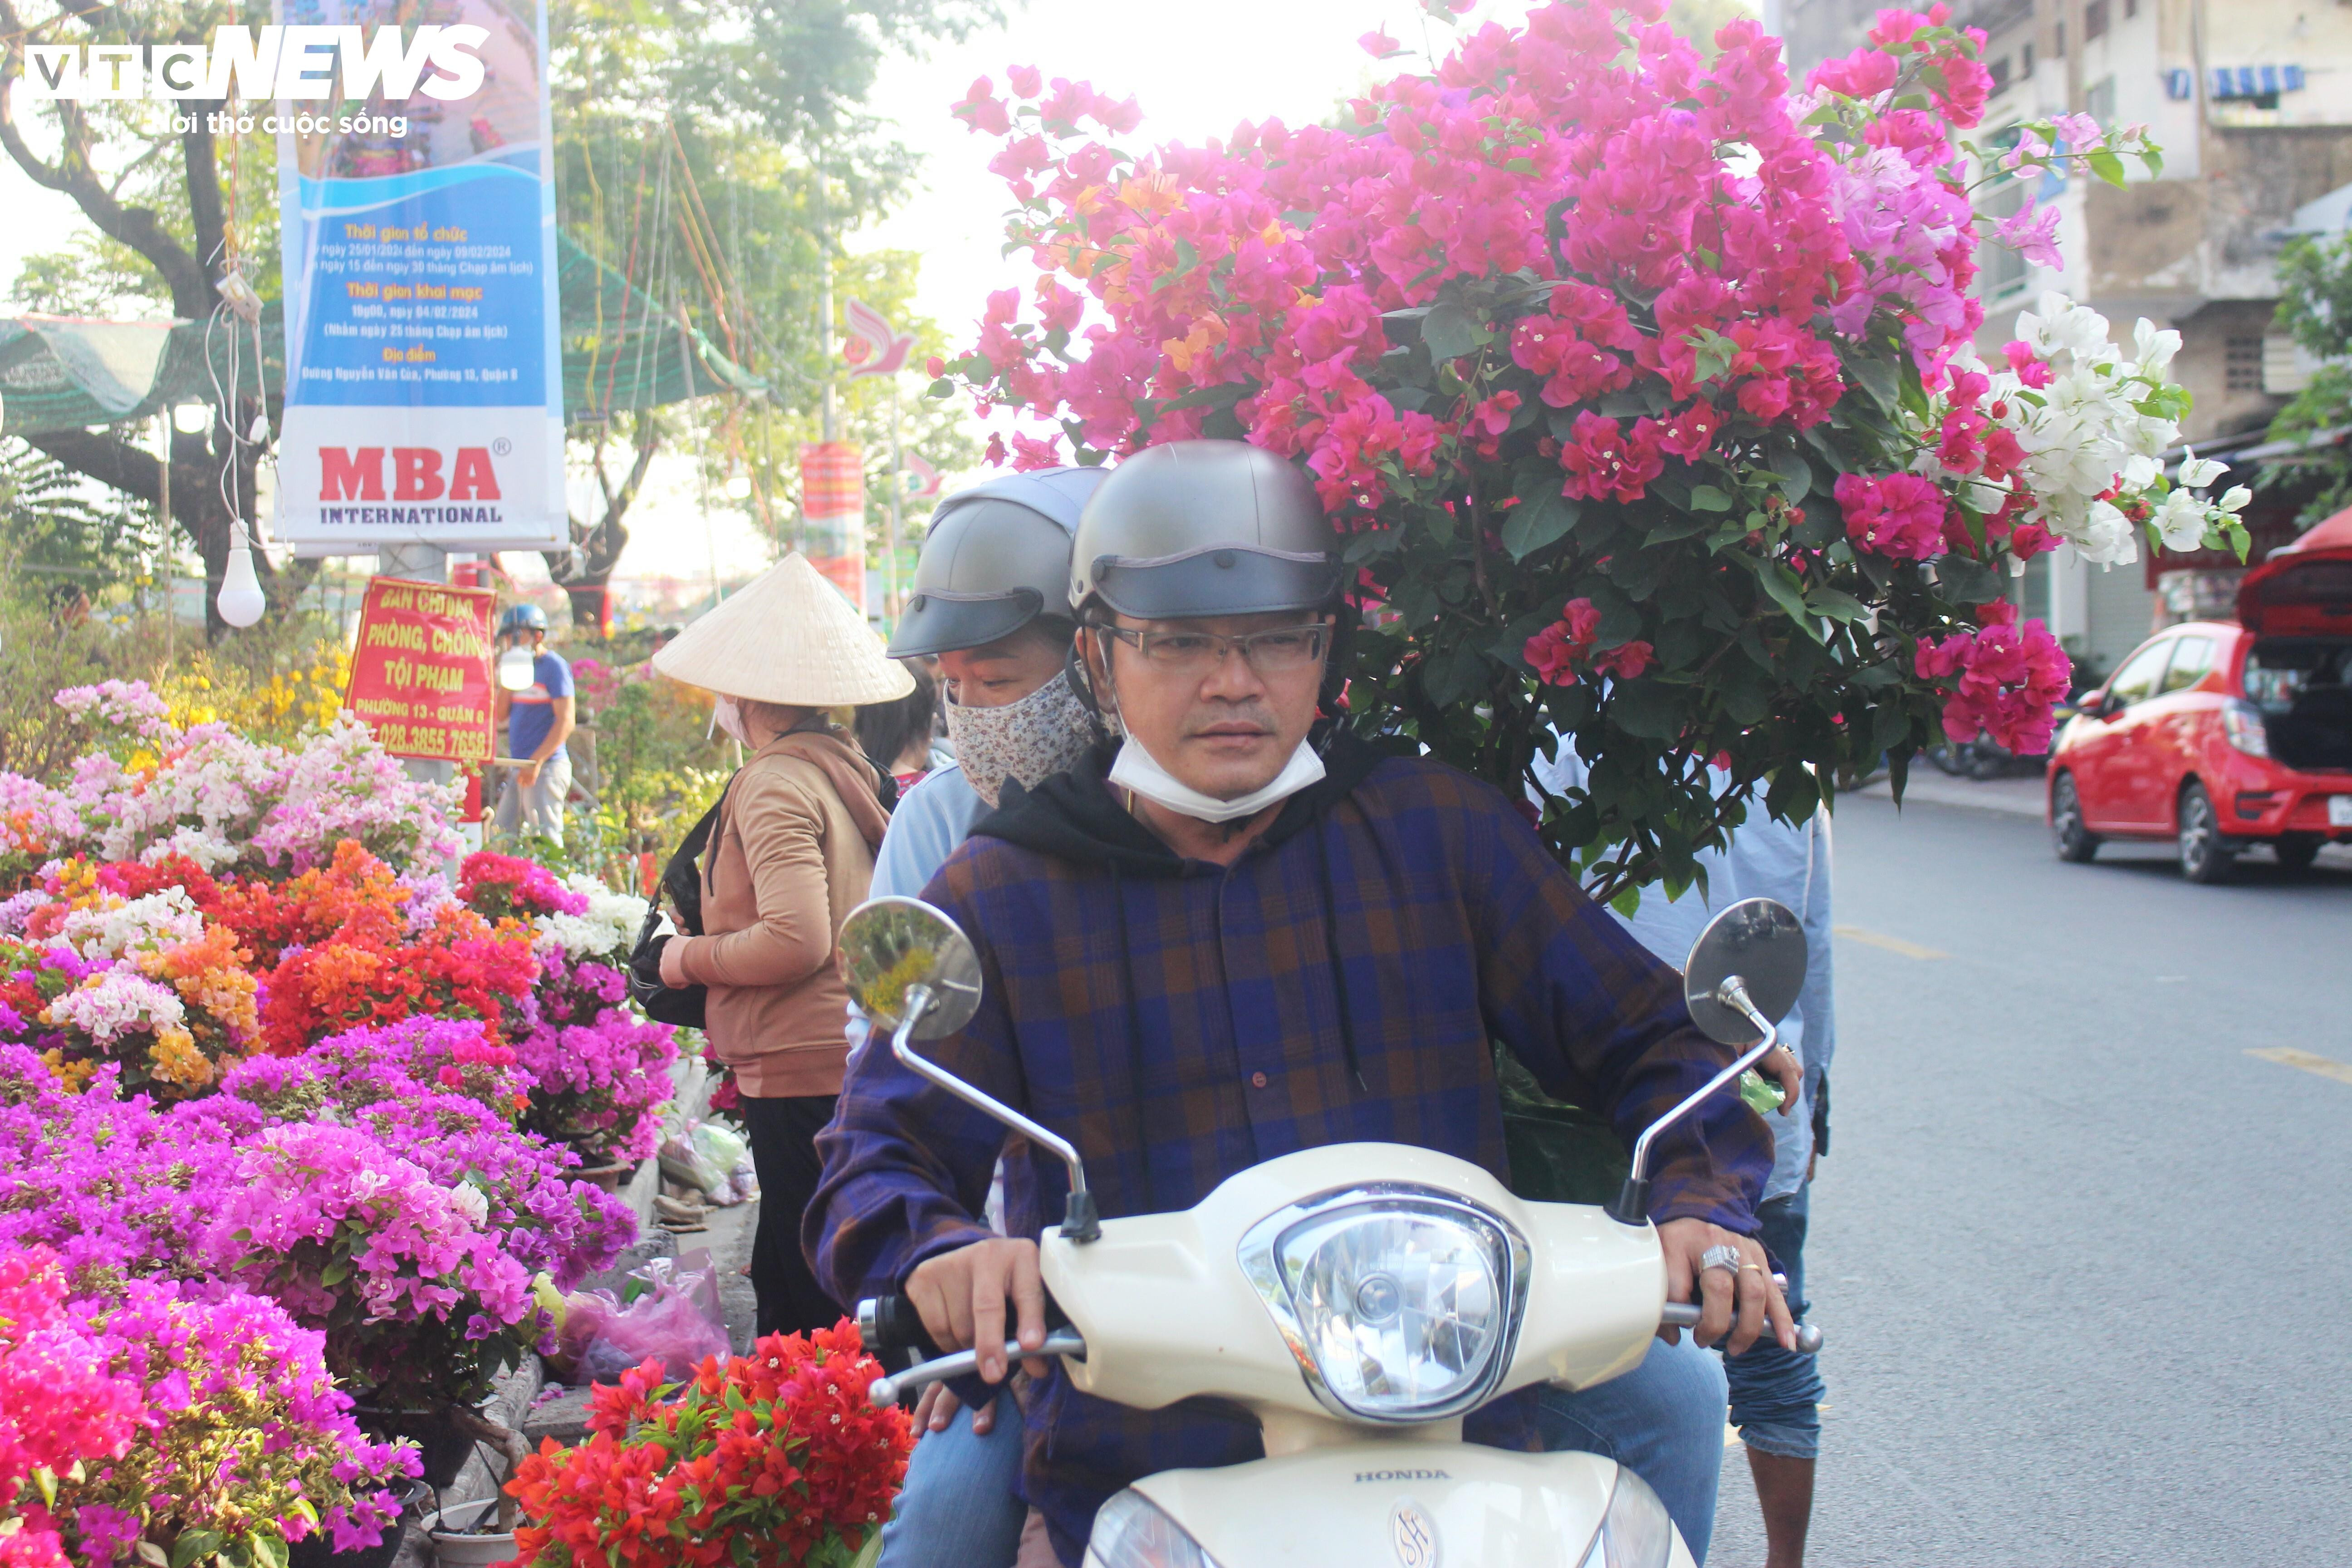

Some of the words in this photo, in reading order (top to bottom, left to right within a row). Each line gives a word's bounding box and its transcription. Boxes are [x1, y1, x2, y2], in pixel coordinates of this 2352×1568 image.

[345, 223, 376, 240] Thời
[380, 225, 409, 243] gian
[348, 259, 360, 271] 15
[412, 260, 424, 272] 30
[346, 281, 379, 298] Thời
[382, 283, 412, 302] gian
[415, 282, 446, 300] khai
[319, 446, 501, 501] MBA
[320, 505, 503, 524] INTERNATIONAL
[367, 617, 427, 656] PHÒNG,
[385, 656, 412, 691] TỘI
[415, 663, 465, 696] PHẠM
[356, 697, 409, 717] PHƯỜNG
[413, 704, 427, 719] 13
[437, 705, 475, 725] QUẬN
[477, 710, 485, 725] 8
[450, 729, 486, 757] 7658
[1354, 1469, 1453, 1483] HONDA
